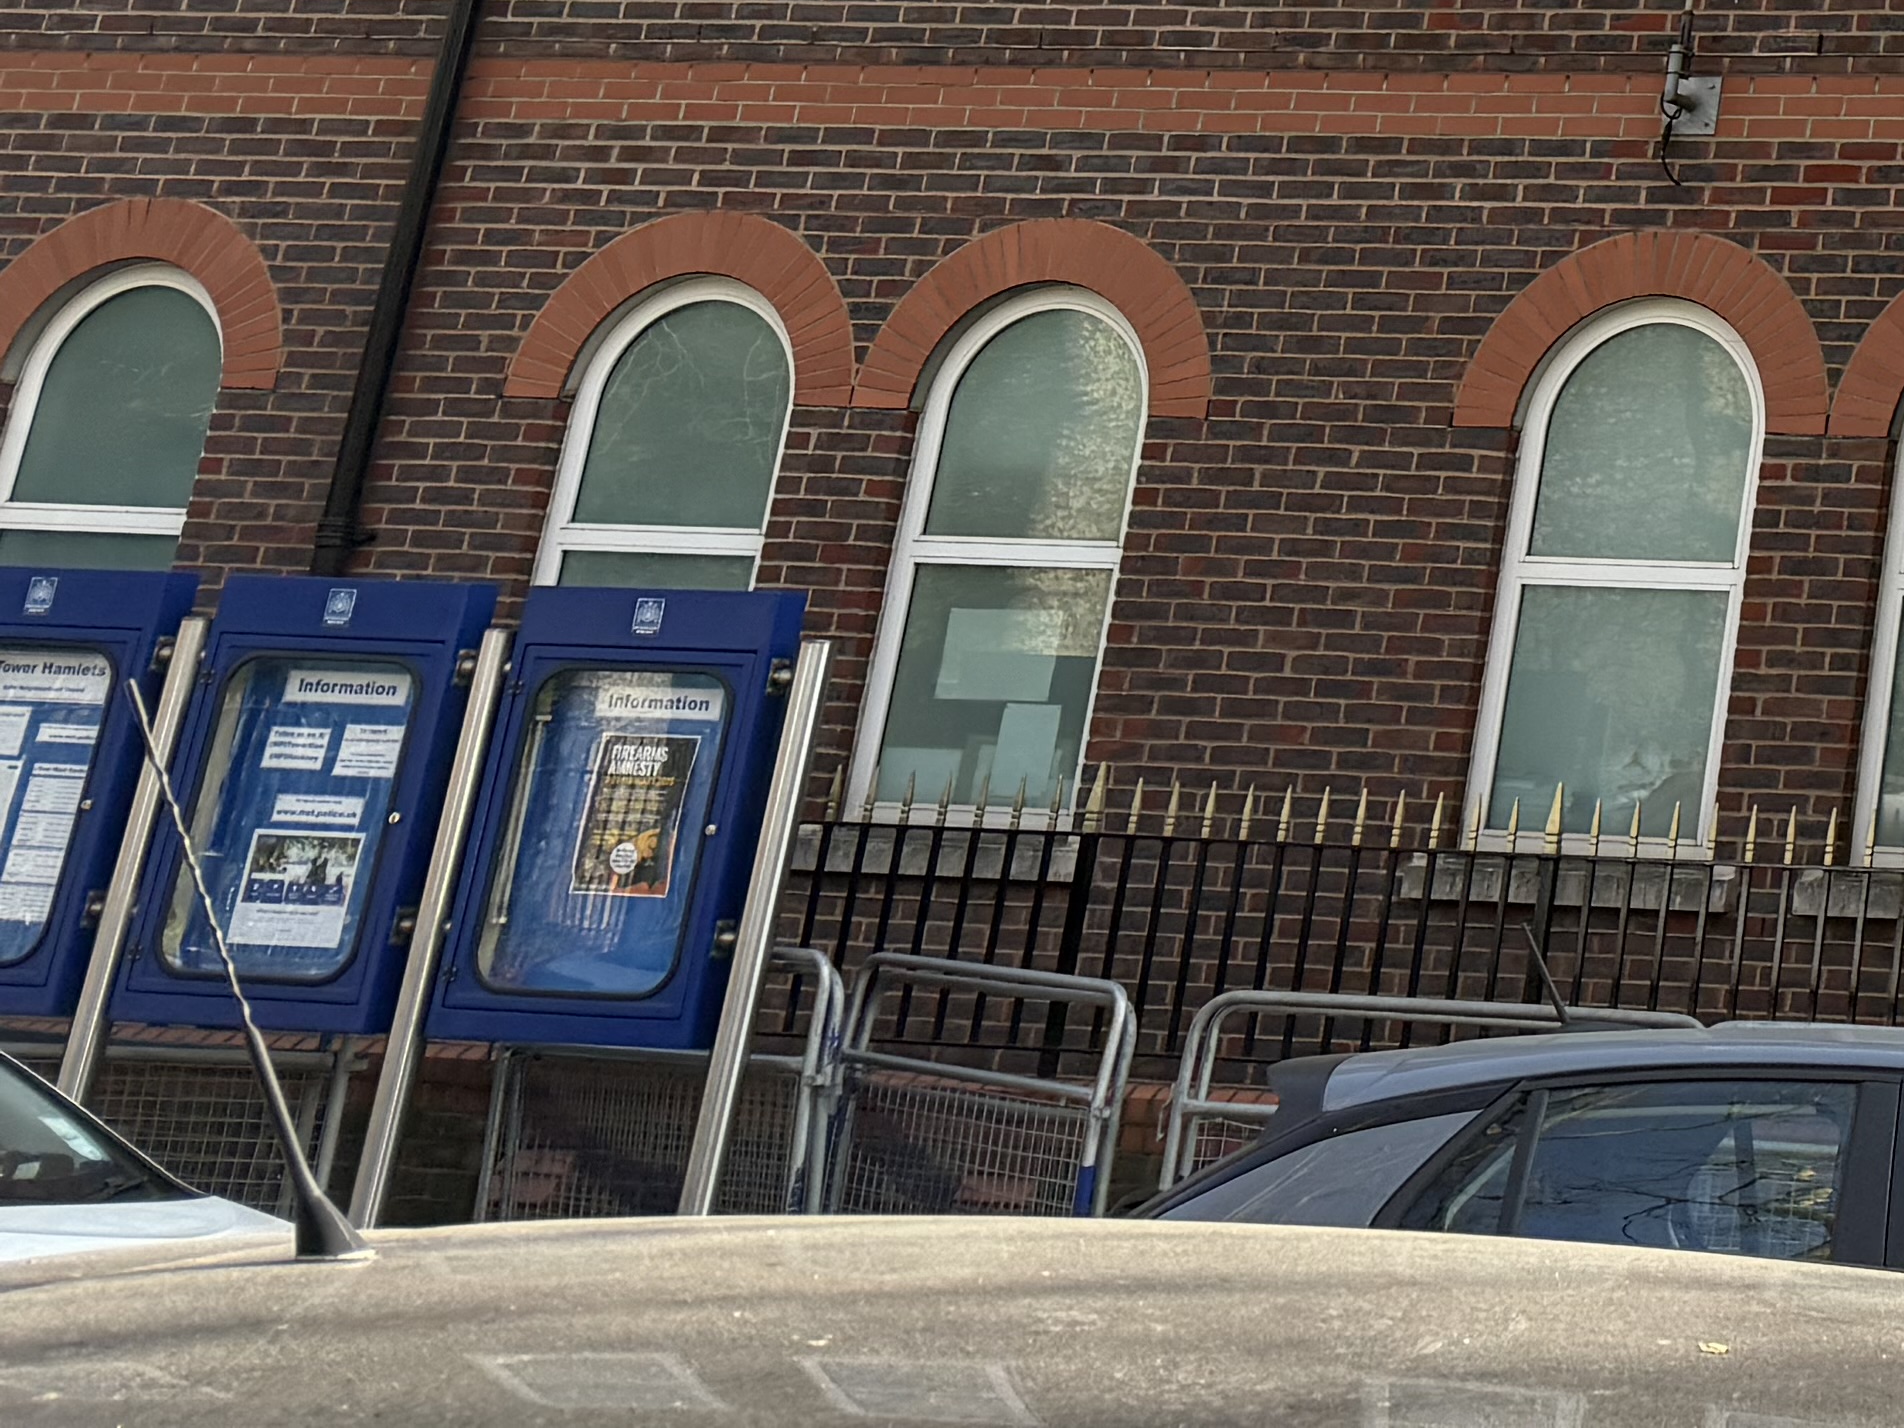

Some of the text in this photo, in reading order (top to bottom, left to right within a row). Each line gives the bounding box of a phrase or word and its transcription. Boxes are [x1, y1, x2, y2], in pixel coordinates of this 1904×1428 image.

[41, 661, 107, 677] Hamlets
[298, 678, 398, 697] Information
[607, 693, 710, 712] Information
[611, 744, 669, 763] FIREARMS
[607, 760, 662, 777] AMNESTY
